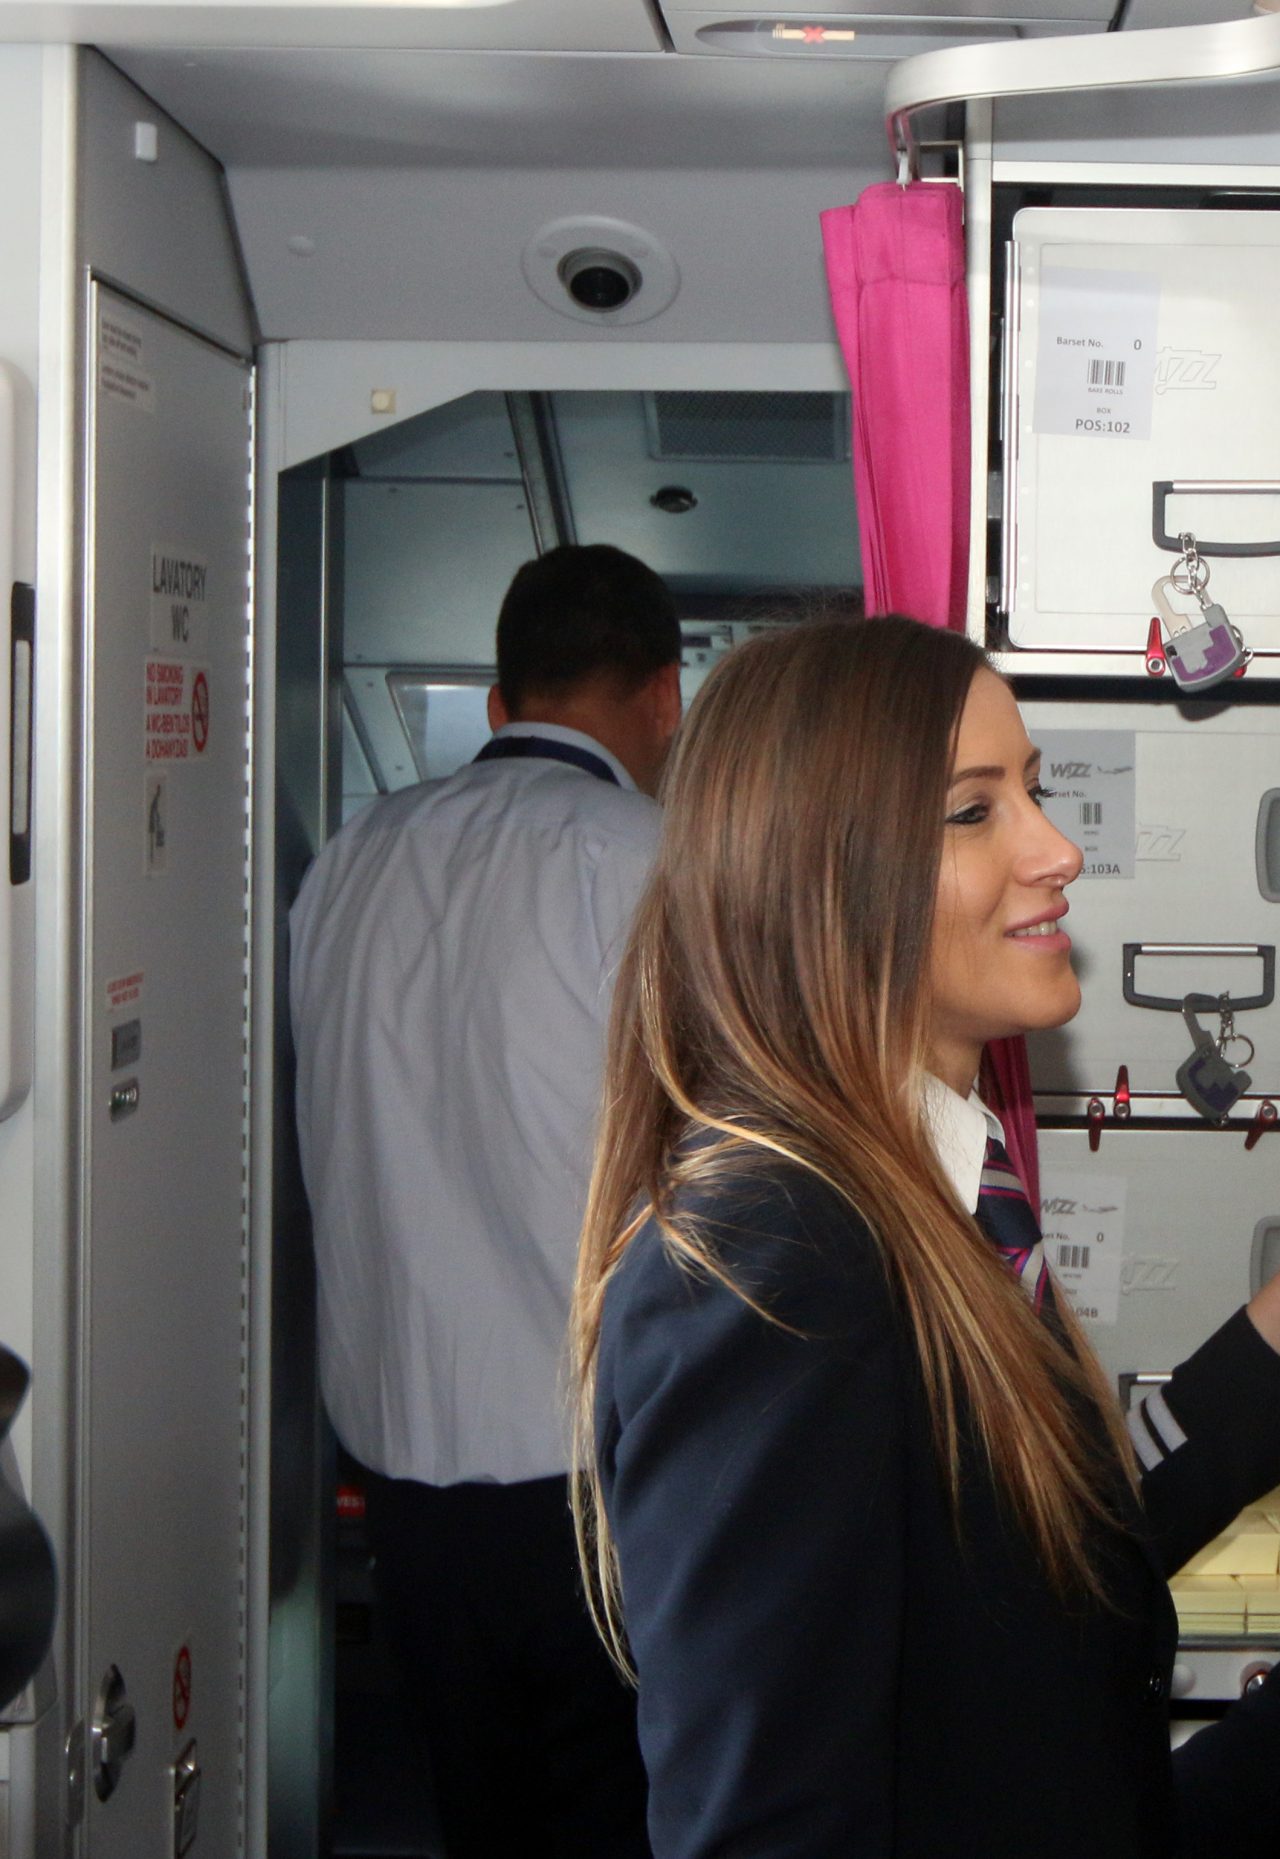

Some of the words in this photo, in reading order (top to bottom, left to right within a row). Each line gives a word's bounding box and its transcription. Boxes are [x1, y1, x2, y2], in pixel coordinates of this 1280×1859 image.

[1056, 336, 1086, 347] Barset
[1088, 338, 1104, 349] No.
[1133, 339, 1142, 351] 0
[1096, 407, 1112, 415] BOX
[1075, 418, 1131, 434] POS:102
[152, 553, 208, 602] LAVATORY
[170, 603, 190, 643] WC
[1050, 761, 1092, 780] WIZZ
[1072, 790, 1087, 799] No.
[1096, 1231, 1105, 1243] 0
